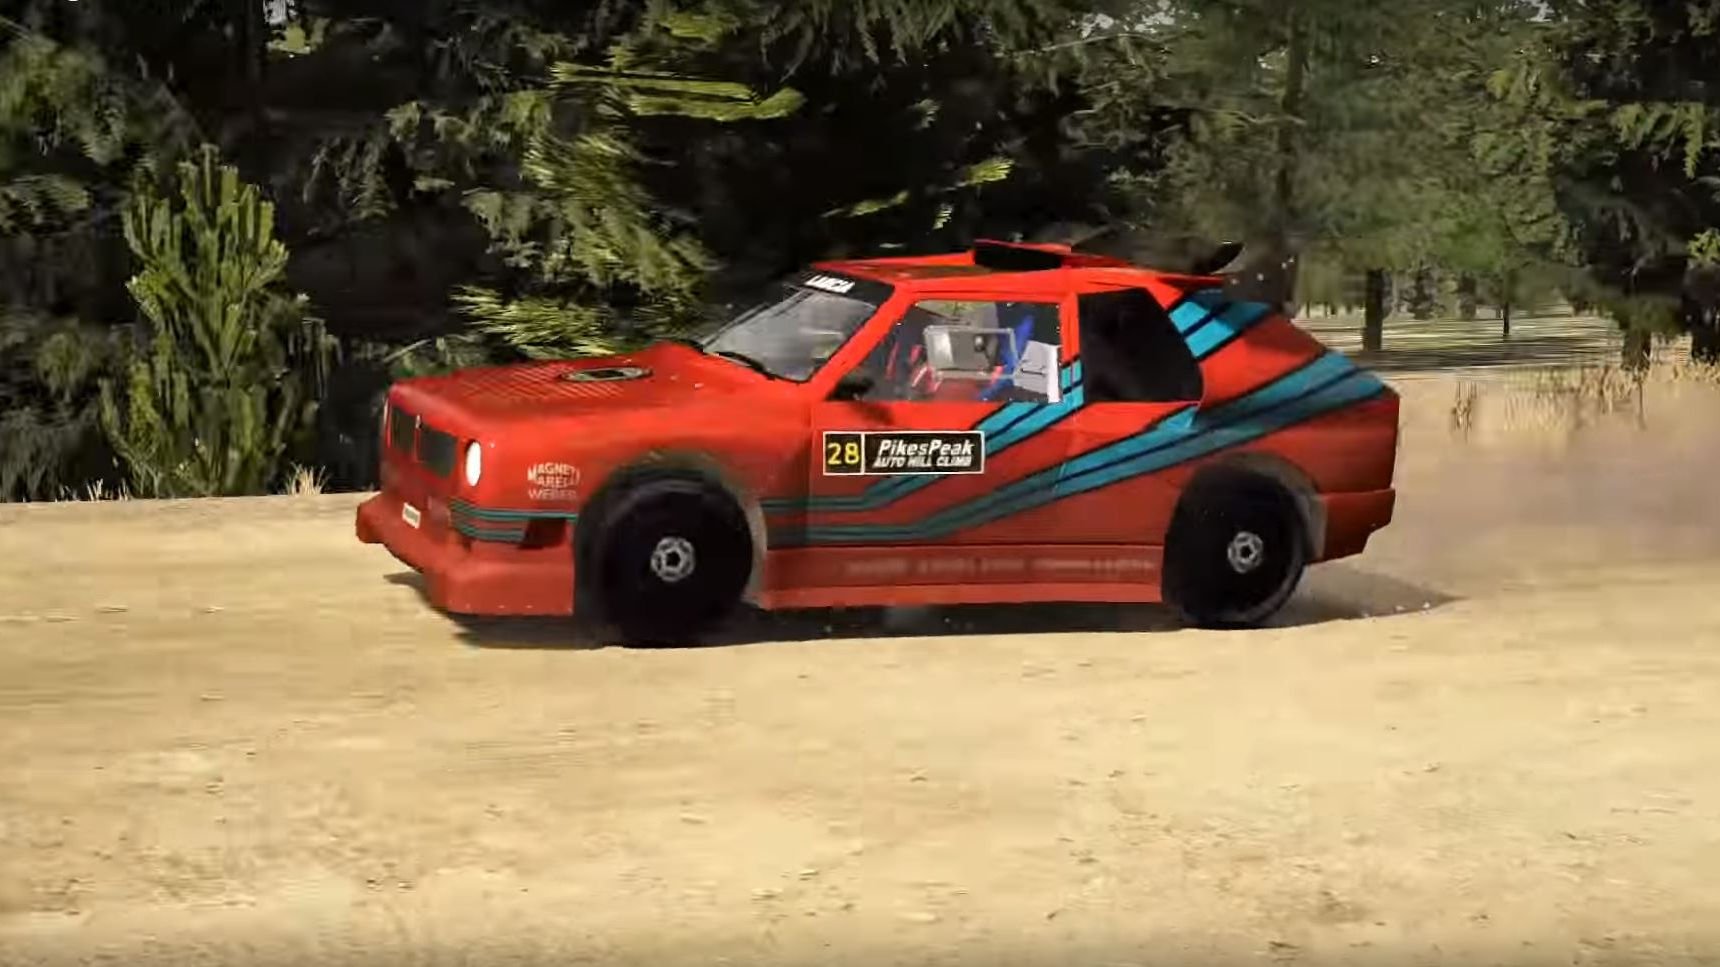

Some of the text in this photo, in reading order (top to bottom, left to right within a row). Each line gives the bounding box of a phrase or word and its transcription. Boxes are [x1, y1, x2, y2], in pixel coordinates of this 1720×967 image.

[827, 442, 860, 465] 28
[879, 439, 975, 456] PikesPeak
[872, 457, 906, 468] AUTO
[936, 456, 973, 467] CLIMB
